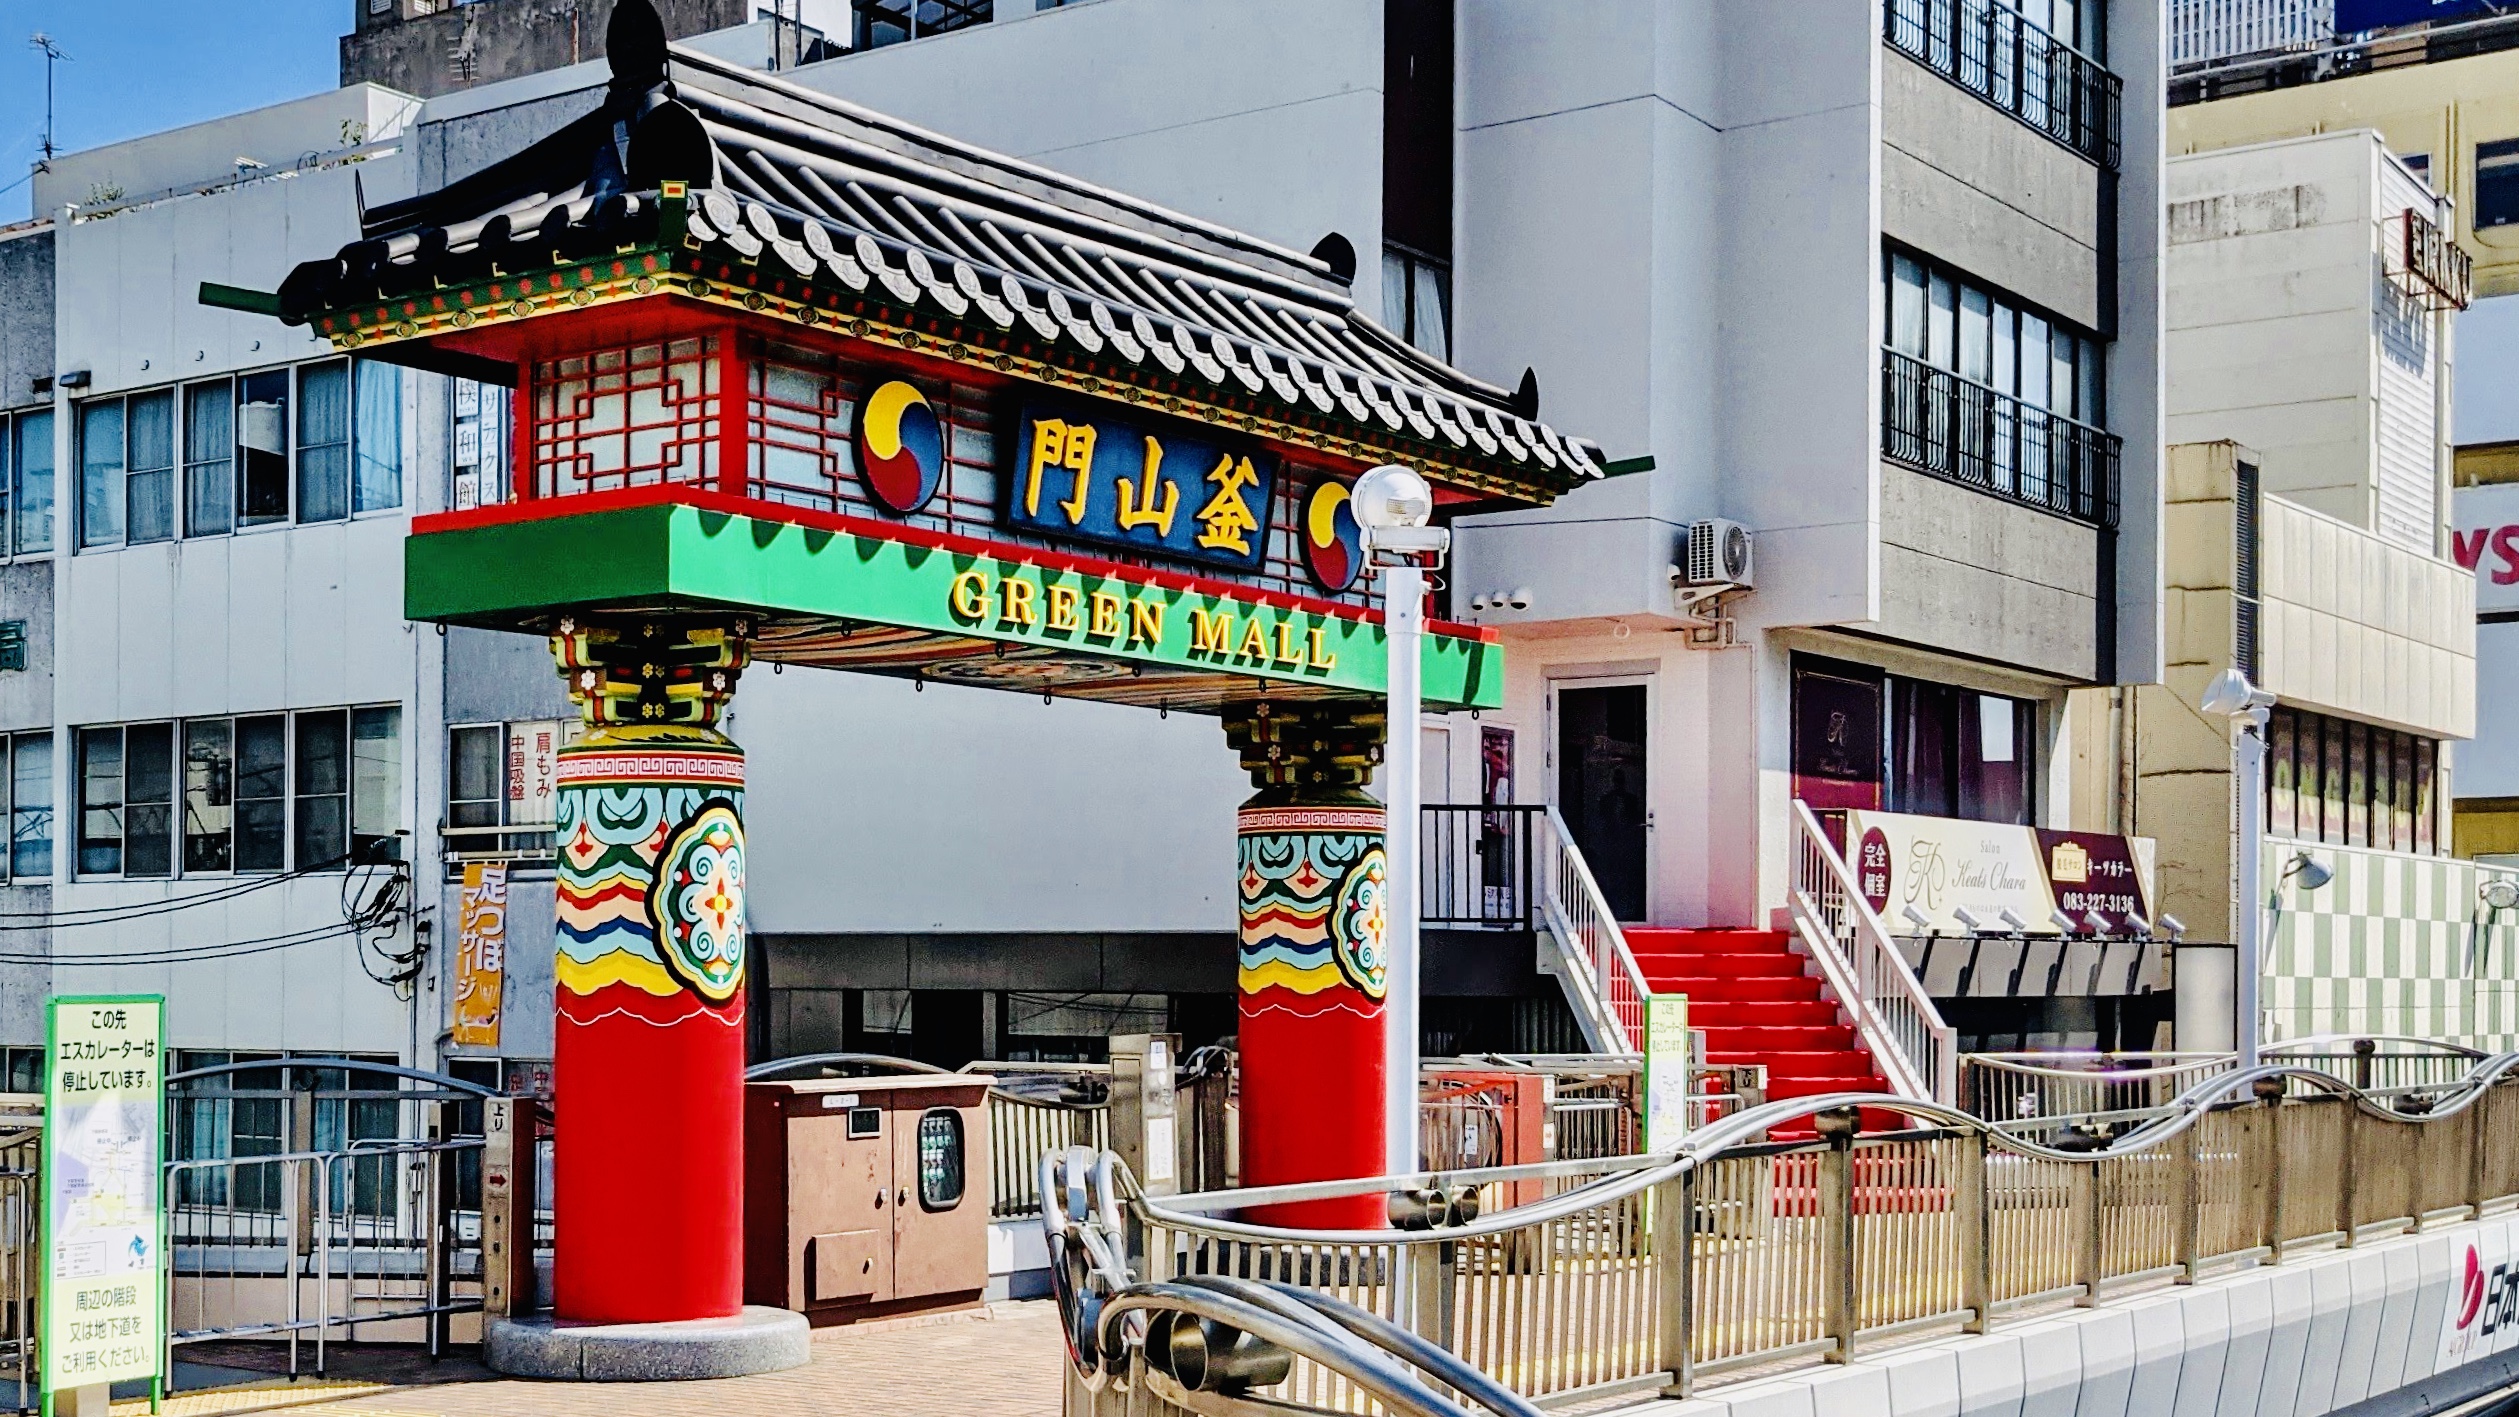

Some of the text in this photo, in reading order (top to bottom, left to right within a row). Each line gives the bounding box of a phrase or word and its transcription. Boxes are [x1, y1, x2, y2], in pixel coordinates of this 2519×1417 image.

[952, 570, 1338, 670] GREEN MALL
[536, 732, 552, 799] 肩もみ
[1980, 839, 2001, 854] Salon
[1951, 858, 2027, 891] Keats Chara
[2063, 891, 2135, 913] 083-227-3136
[476, 867, 507, 972] 足つぼ
[455, 887, 481, 1001] マッサージ
[91, 1008, 127, 1030] この先
[60, 1039, 155, 1061] エスカレーターは
[62, 1069, 152, 1093] 停止しています。
[493, 1102, 504, 1131] 上り
[76, 1285, 137, 1312] 周辺の階段
[69, 1315, 141, 1343] 又は地下道を
[61, 1345, 150, 1374] ご利用ください。
